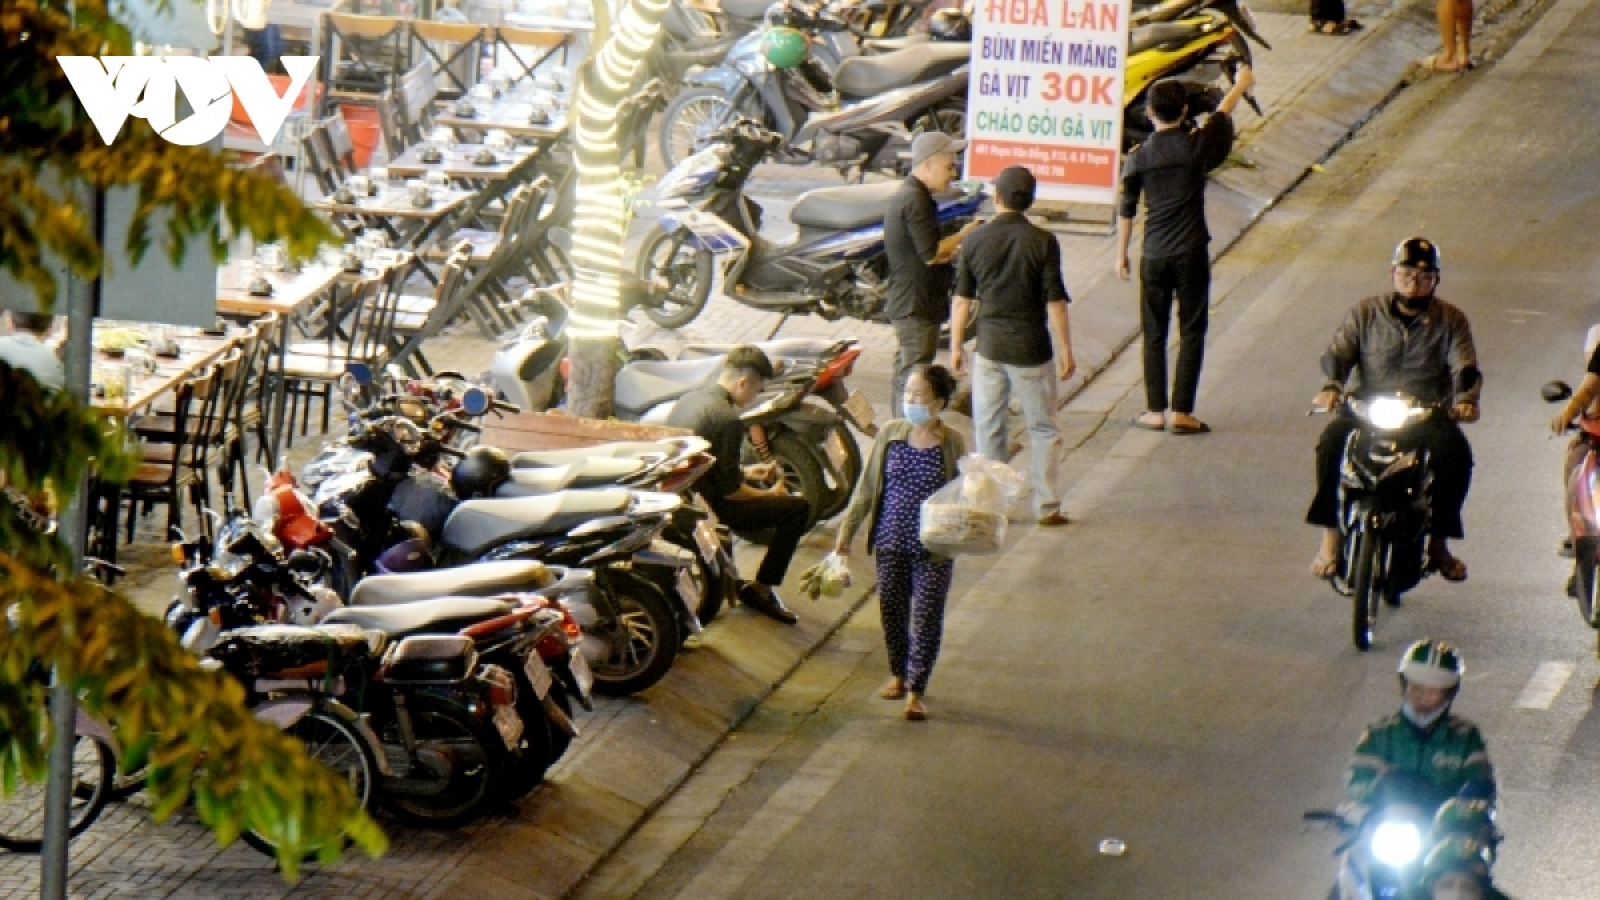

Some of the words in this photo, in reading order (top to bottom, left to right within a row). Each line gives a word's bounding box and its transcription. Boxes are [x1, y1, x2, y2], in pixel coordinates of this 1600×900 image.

[984, 0, 1049, 26] HOA
[1060, 0, 1118, 32] LAN
[981, 32, 1016, 60] BÚN
[1020, 33, 1063, 64] MIẾN
[979, 68, 1000, 96] GÀ
[1006, 73, 1031, 104] VỊT
[1040, 71, 1115, 105] 30K
[976, 107, 1022, 133] CHÁO
[1062, 111, 1084, 137] GÀ
[1091, 119, 1114, 146] VỊT
